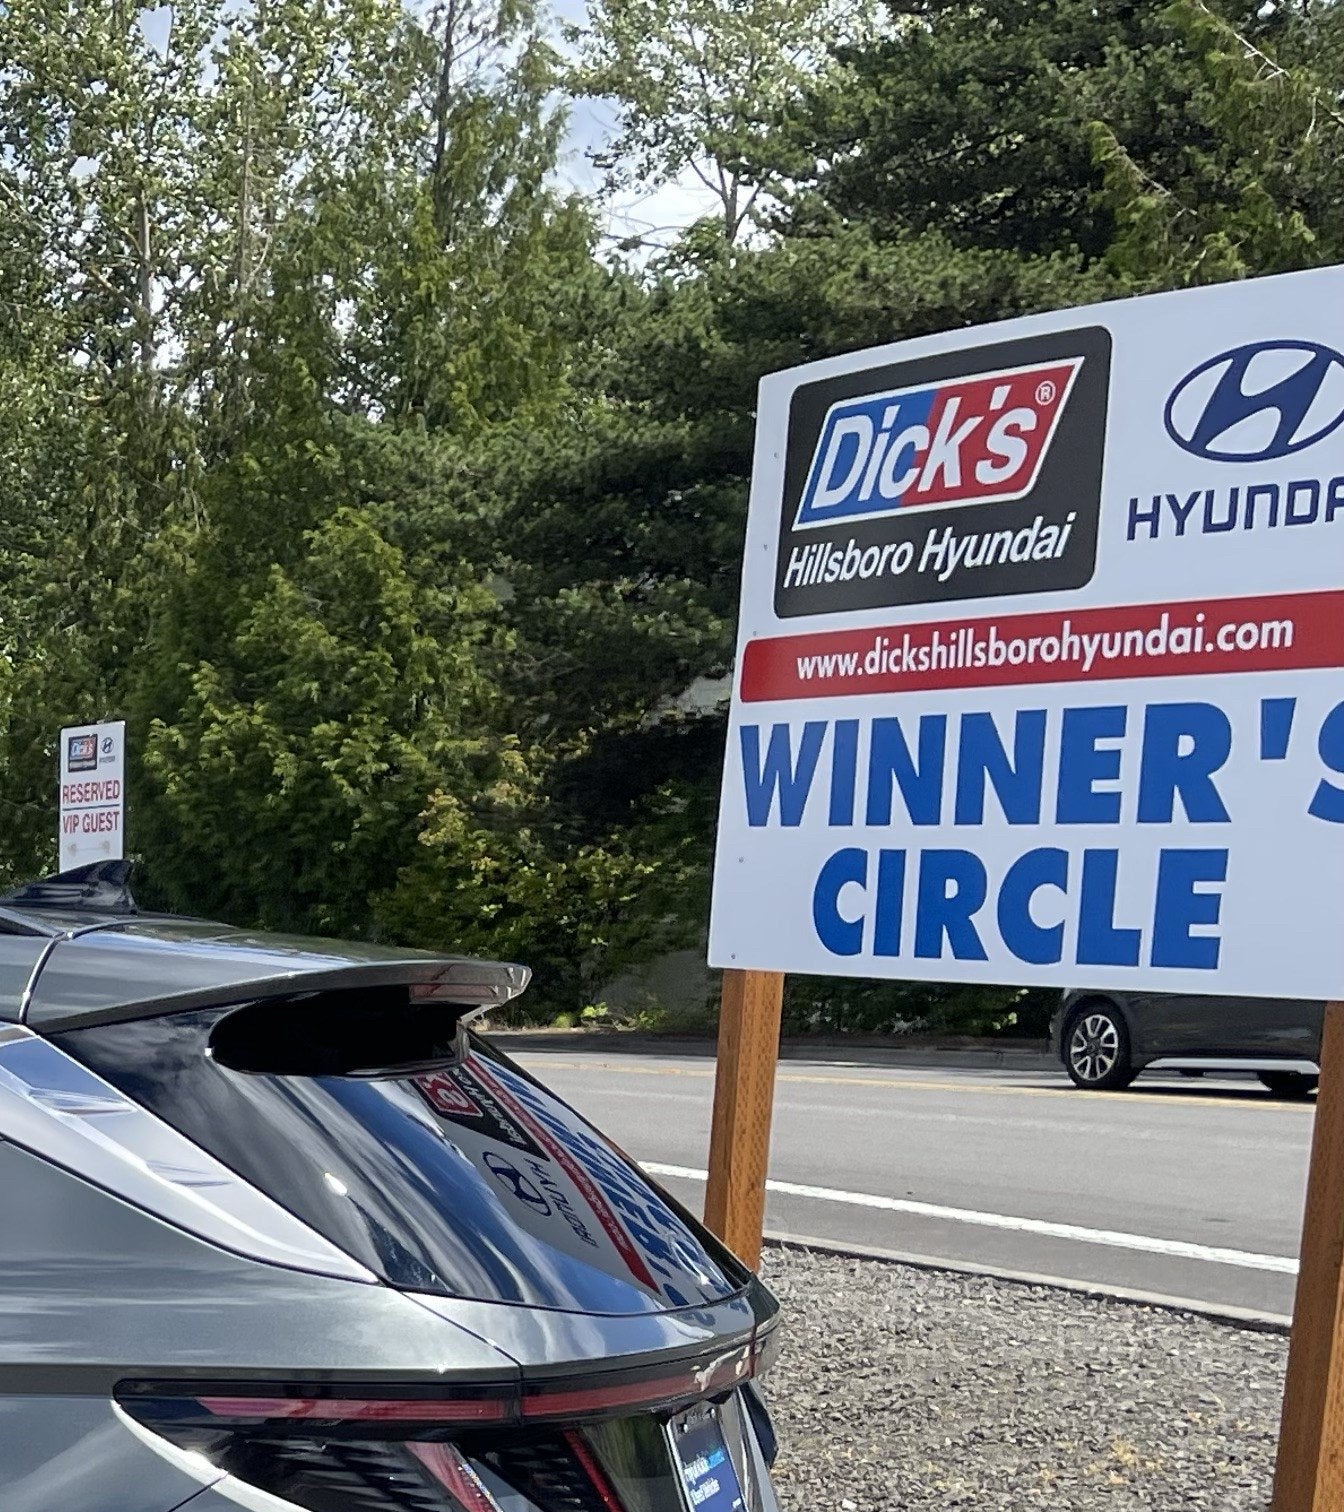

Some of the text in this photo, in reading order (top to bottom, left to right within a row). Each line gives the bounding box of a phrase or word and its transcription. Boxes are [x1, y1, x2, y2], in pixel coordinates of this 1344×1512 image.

[811, 385, 1037, 509] Dick's
[783, 512, 1077, 588] Hillsboro Hyundai
[797, 613, 1294, 680] www.dickshillsborohyundai.com
[62, 779, 121, 805] RESERVED
[62, 811, 120, 834] VIP GUEST
[813, 847, 1229, 970] CIRCLE
